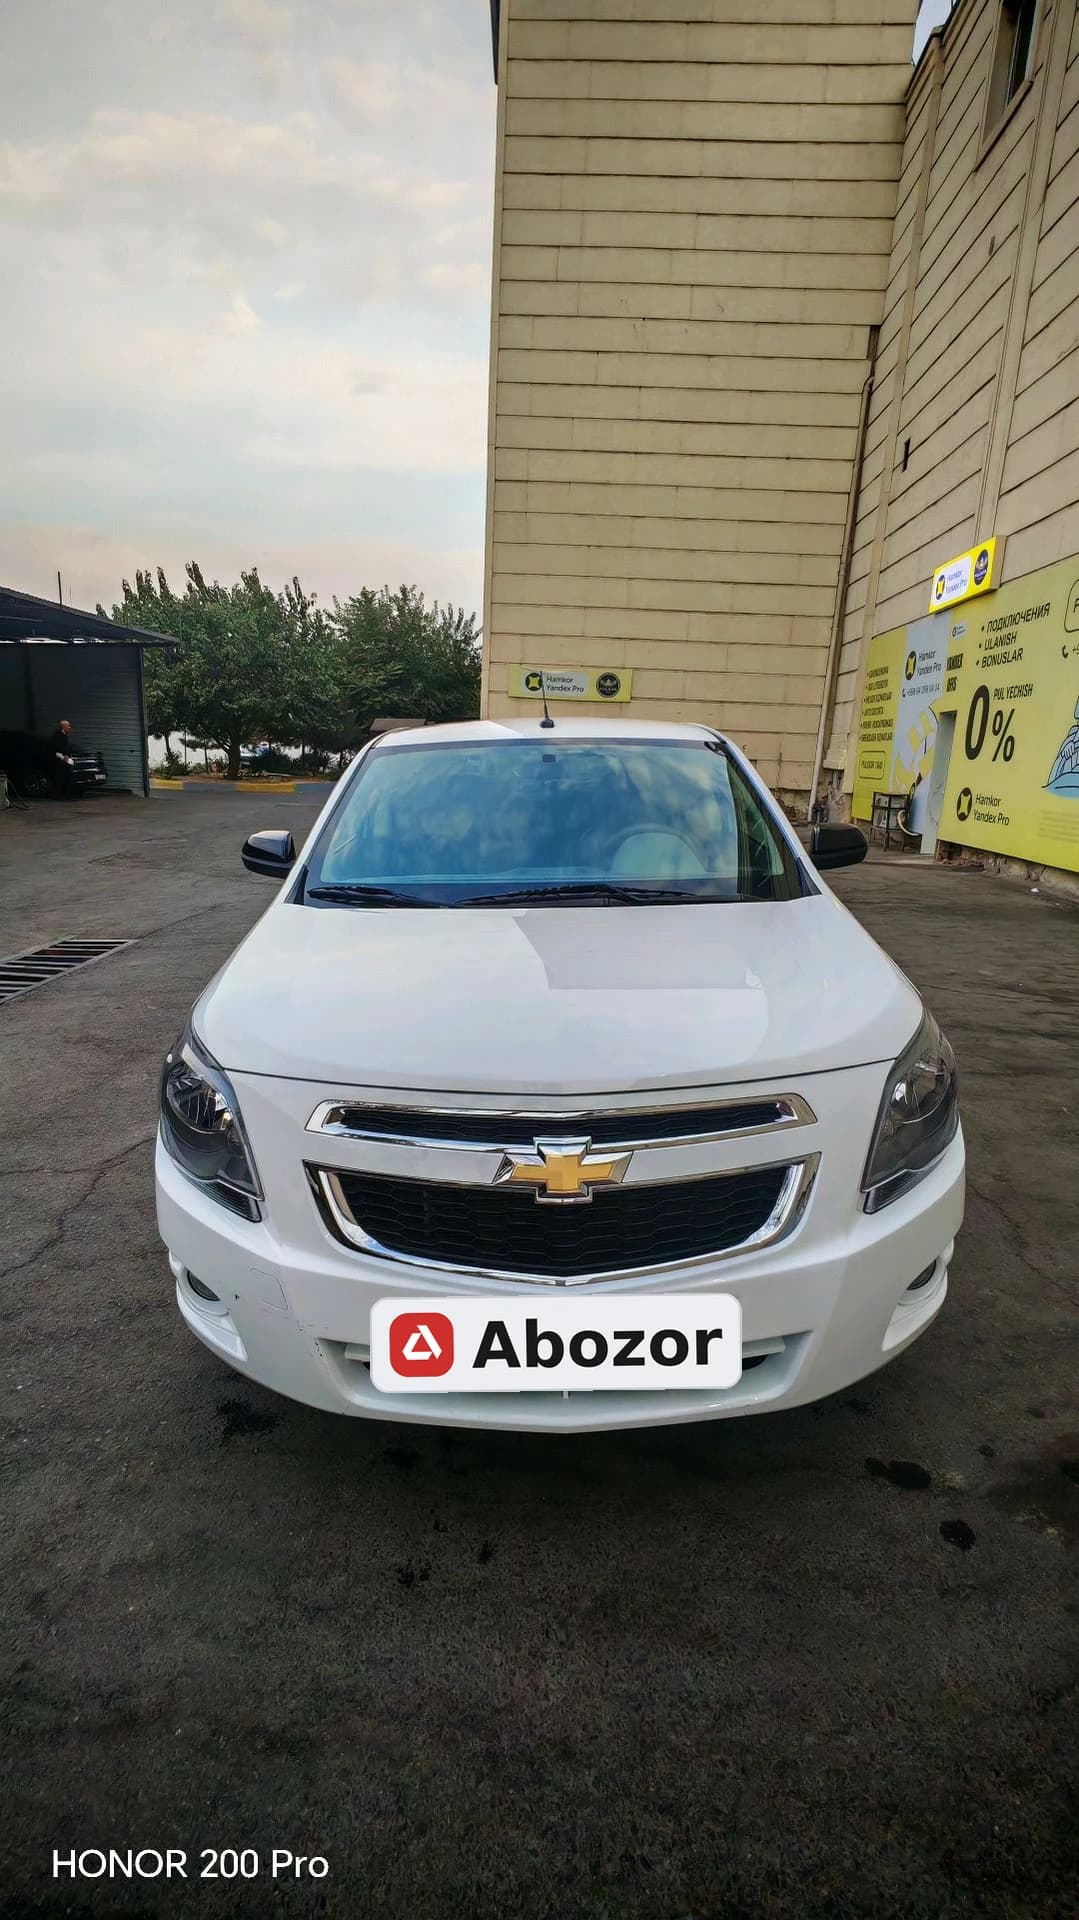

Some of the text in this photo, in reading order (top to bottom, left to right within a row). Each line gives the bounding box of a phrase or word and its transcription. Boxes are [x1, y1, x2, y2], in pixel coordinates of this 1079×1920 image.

[987, 602, 1051, 633] ПОДКЛЮЧЕНИЯ
[984, 631, 1017, 650] ULANISH
[981, 648, 1023, 668] BONUSLAR
[546, 684, 585, 693] Yandex Pro
[993, 683, 1034, 700] PUL YECHISH
[975, 793, 1001, 807] Hamkor
[973, 809, 1010, 826] Yandex Pro
